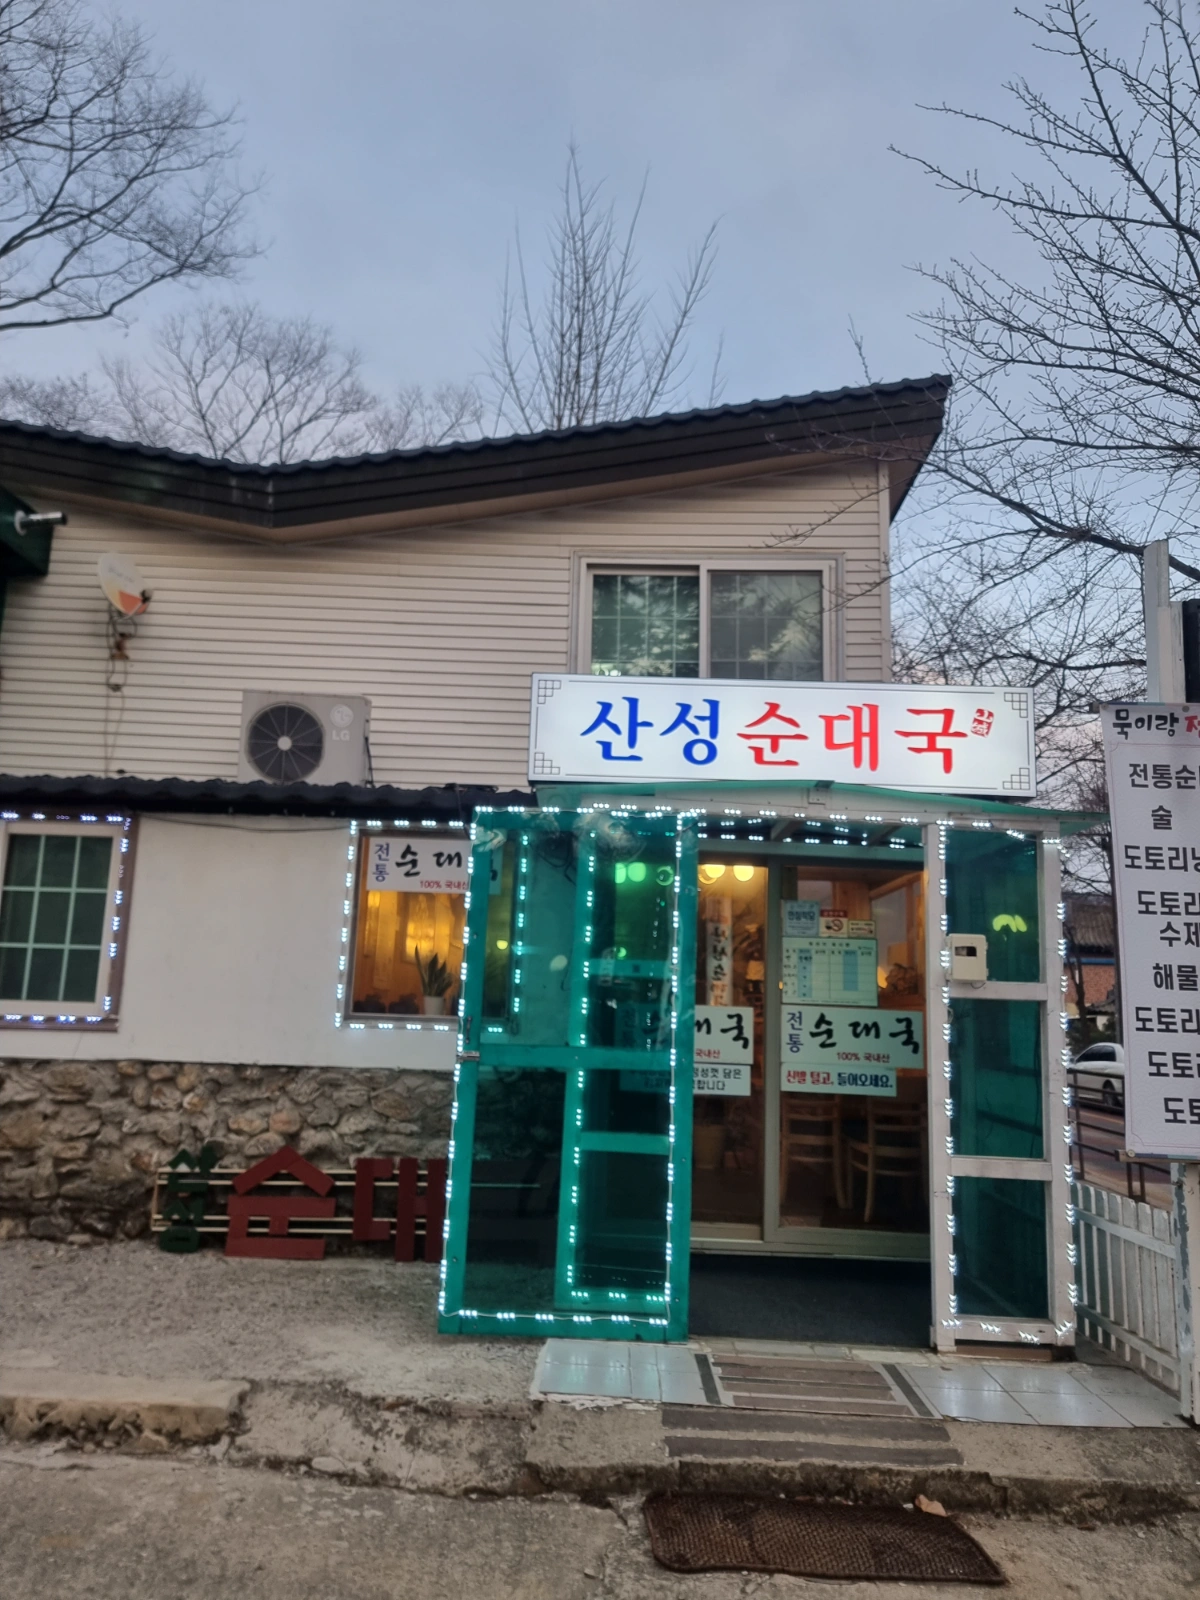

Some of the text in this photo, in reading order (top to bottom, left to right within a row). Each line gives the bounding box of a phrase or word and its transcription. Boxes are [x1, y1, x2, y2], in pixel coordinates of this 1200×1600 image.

[332, 729, 350, 741] LG
[580, 696, 969, 775] 산성 순대국
[1112, 708, 1180, 740] 묵이랑
[1128, 763, 1200, 790] 전통순
[1151, 804, 1173, 831] 술
[372, 842, 390, 882] 전통
[419, 879, 442, 889] 100%
[1152, 962, 1199, 992] 해물
[786, 1010, 920, 1055] 전통 순대국
[836, 1052, 890, 1064] 100% 국내산
[1148, 1051, 1200, 1079] 도토
[786, 1070, 807, 1085] 신발
[837, 1072, 893, 1089] 들어오세요.
